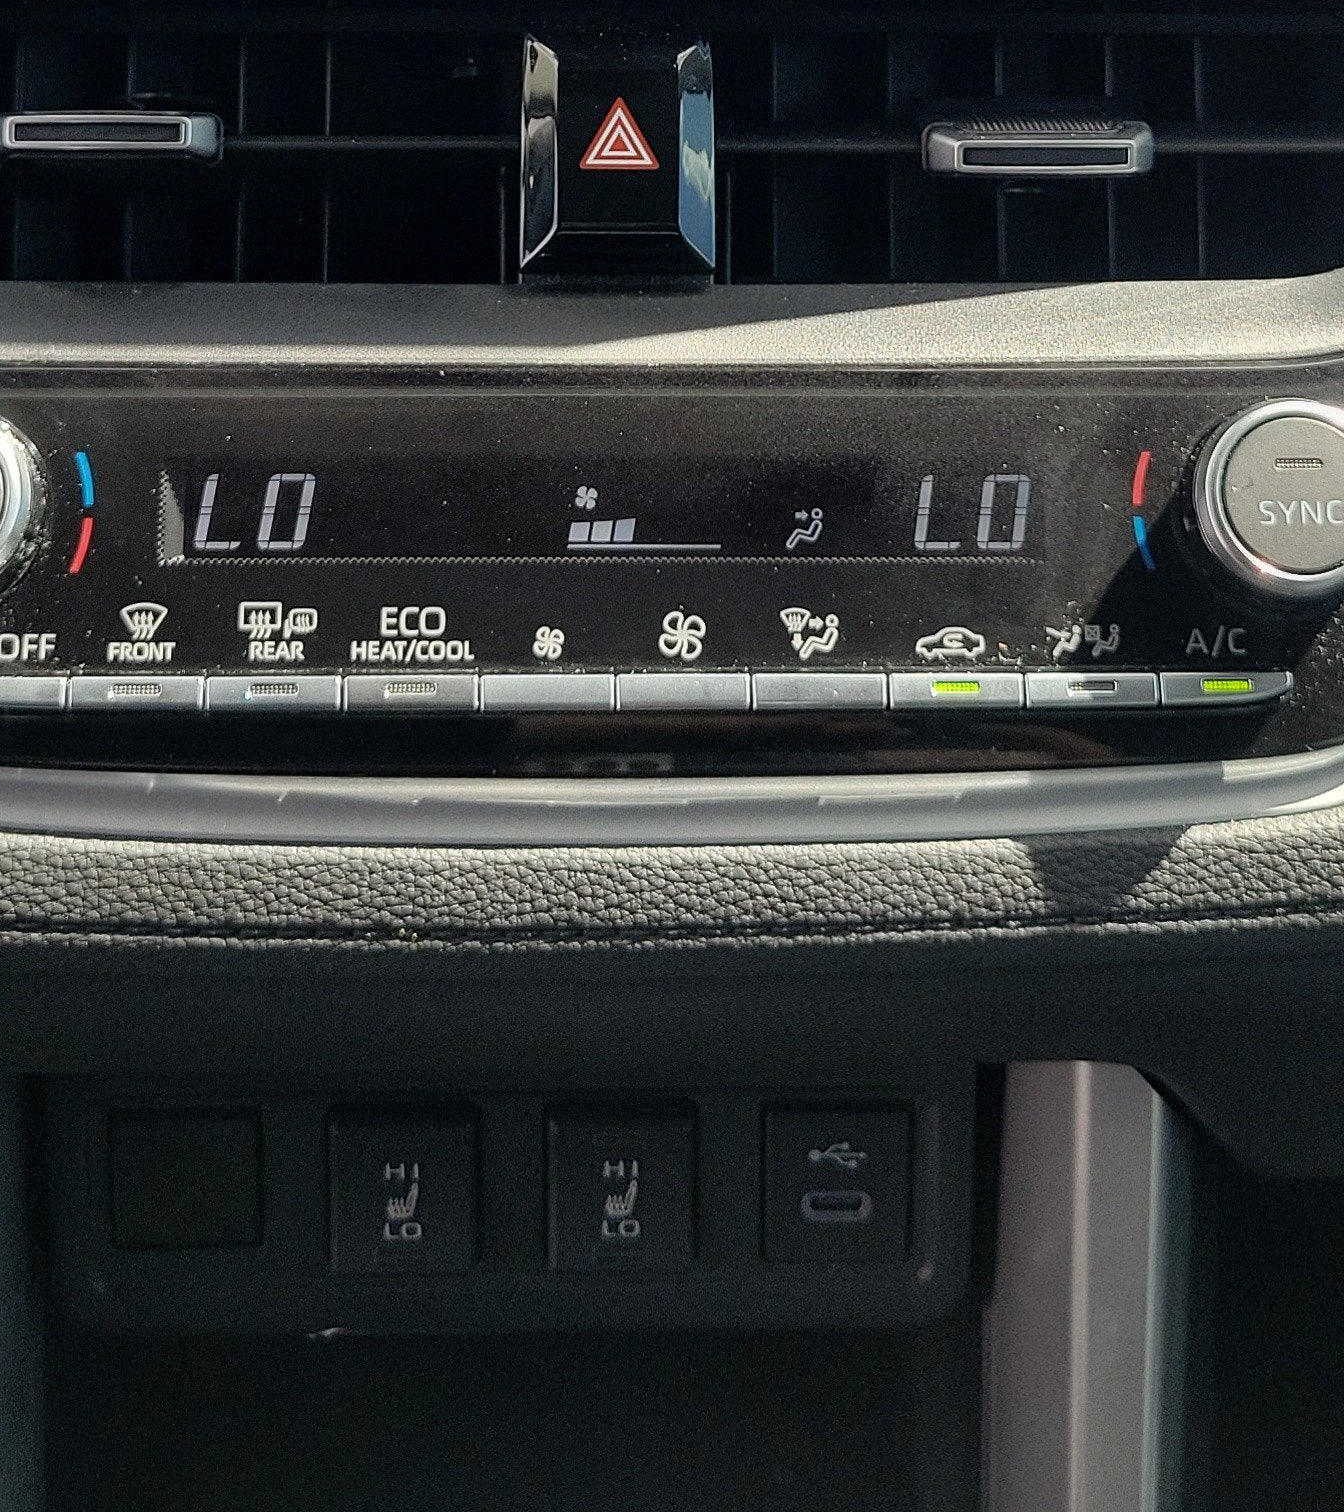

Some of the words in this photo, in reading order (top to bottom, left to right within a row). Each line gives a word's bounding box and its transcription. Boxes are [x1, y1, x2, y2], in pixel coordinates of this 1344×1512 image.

[1258, 497, 1344, 527] SYNC
[380, 605, 448, 636] ECO
[248, 640, 305, 662] REAR
[349, 639, 476, 662] HEAT/COOL
[1185, 625, 1248, 656] A/C
[106, 641, 177, 662] FRONT
[384, 1161, 420, 1182] HI
[604, 1159, 640, 1180] HI
[383, 1220, 423, 1241] LO
[601, 1218, 642, 1239] LO
